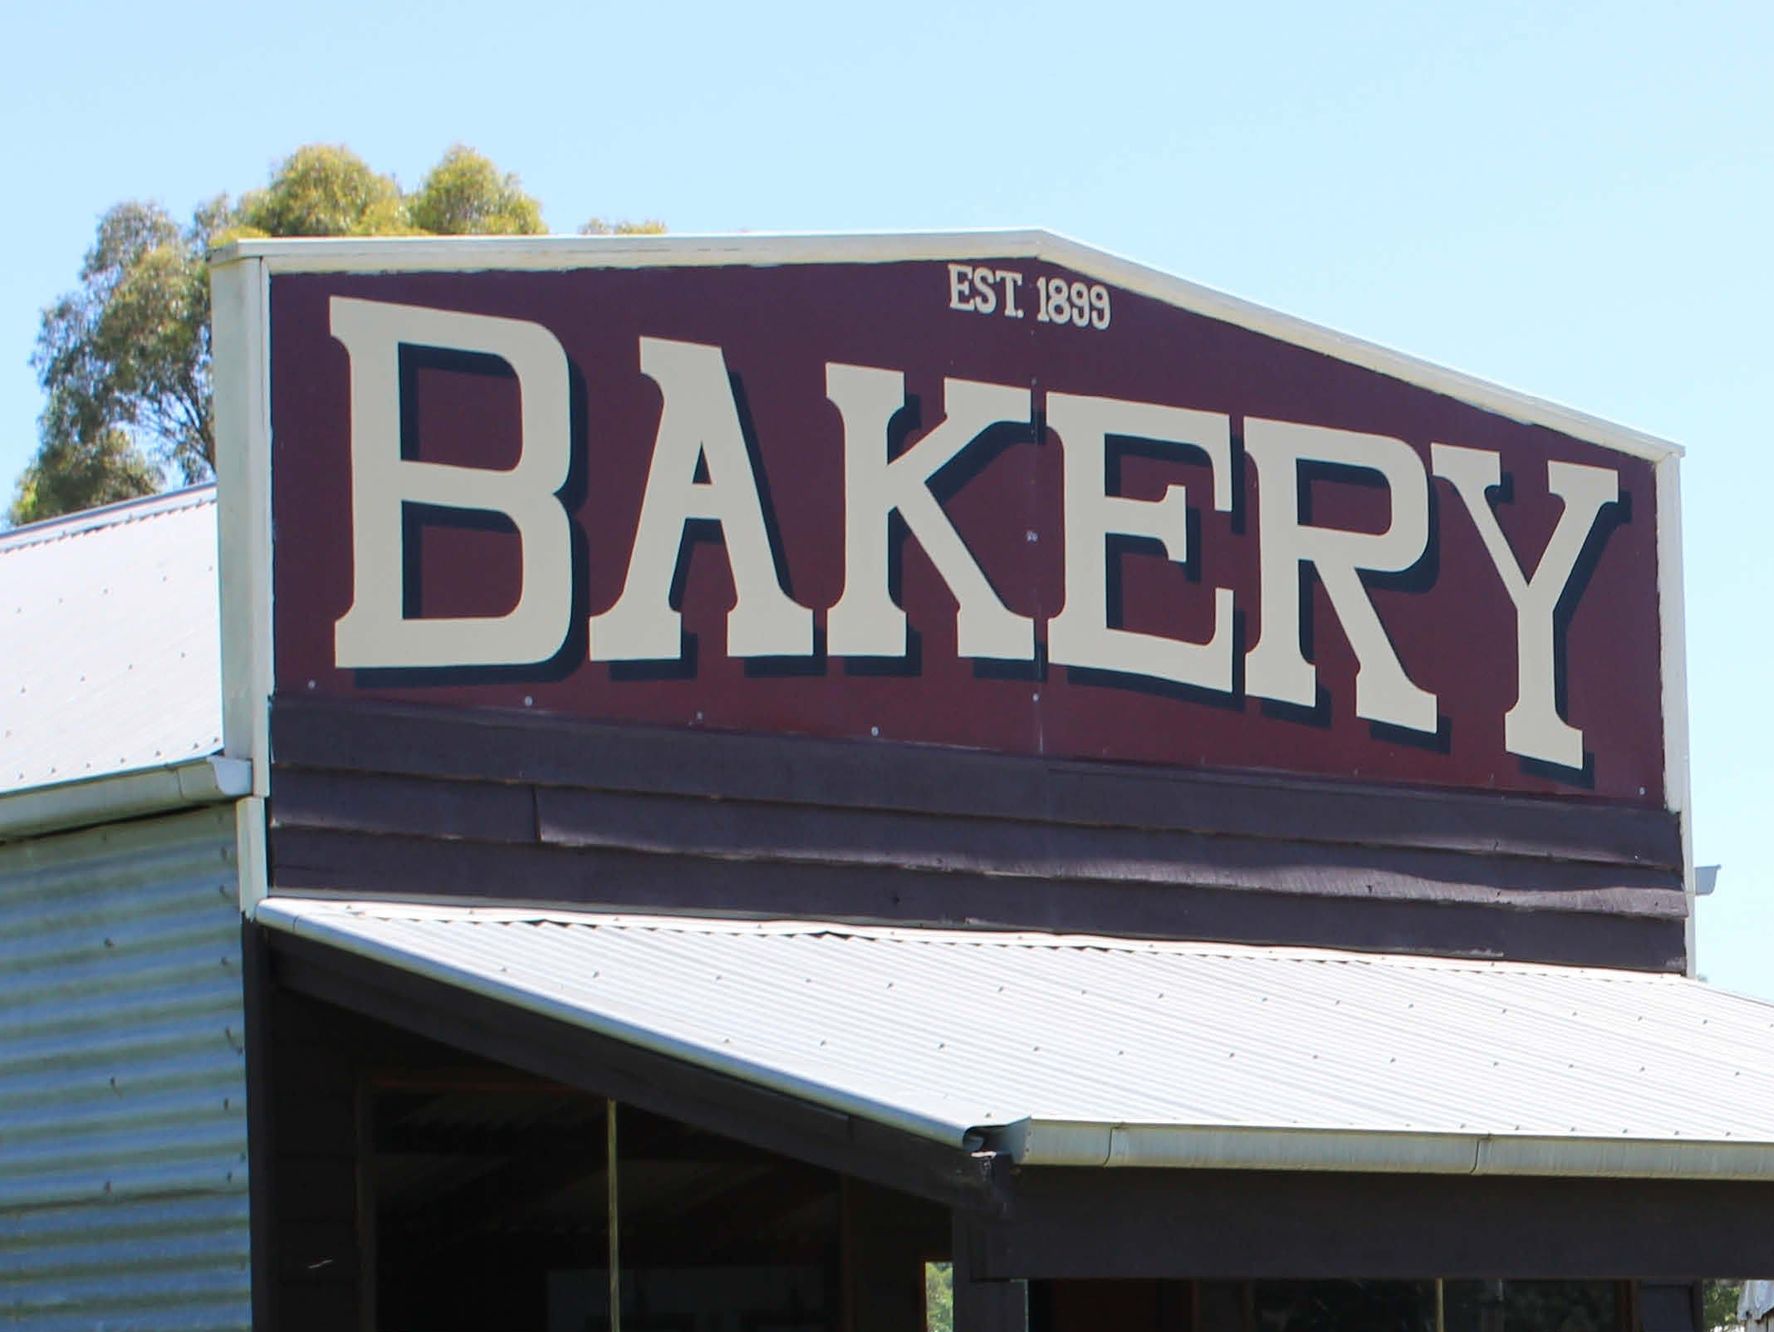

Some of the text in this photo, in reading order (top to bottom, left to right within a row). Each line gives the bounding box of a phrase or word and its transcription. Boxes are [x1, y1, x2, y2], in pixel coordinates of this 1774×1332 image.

[948, 263, 1111, 330] EST. 1899
[329, 294, 1619, 770] BAKERY
